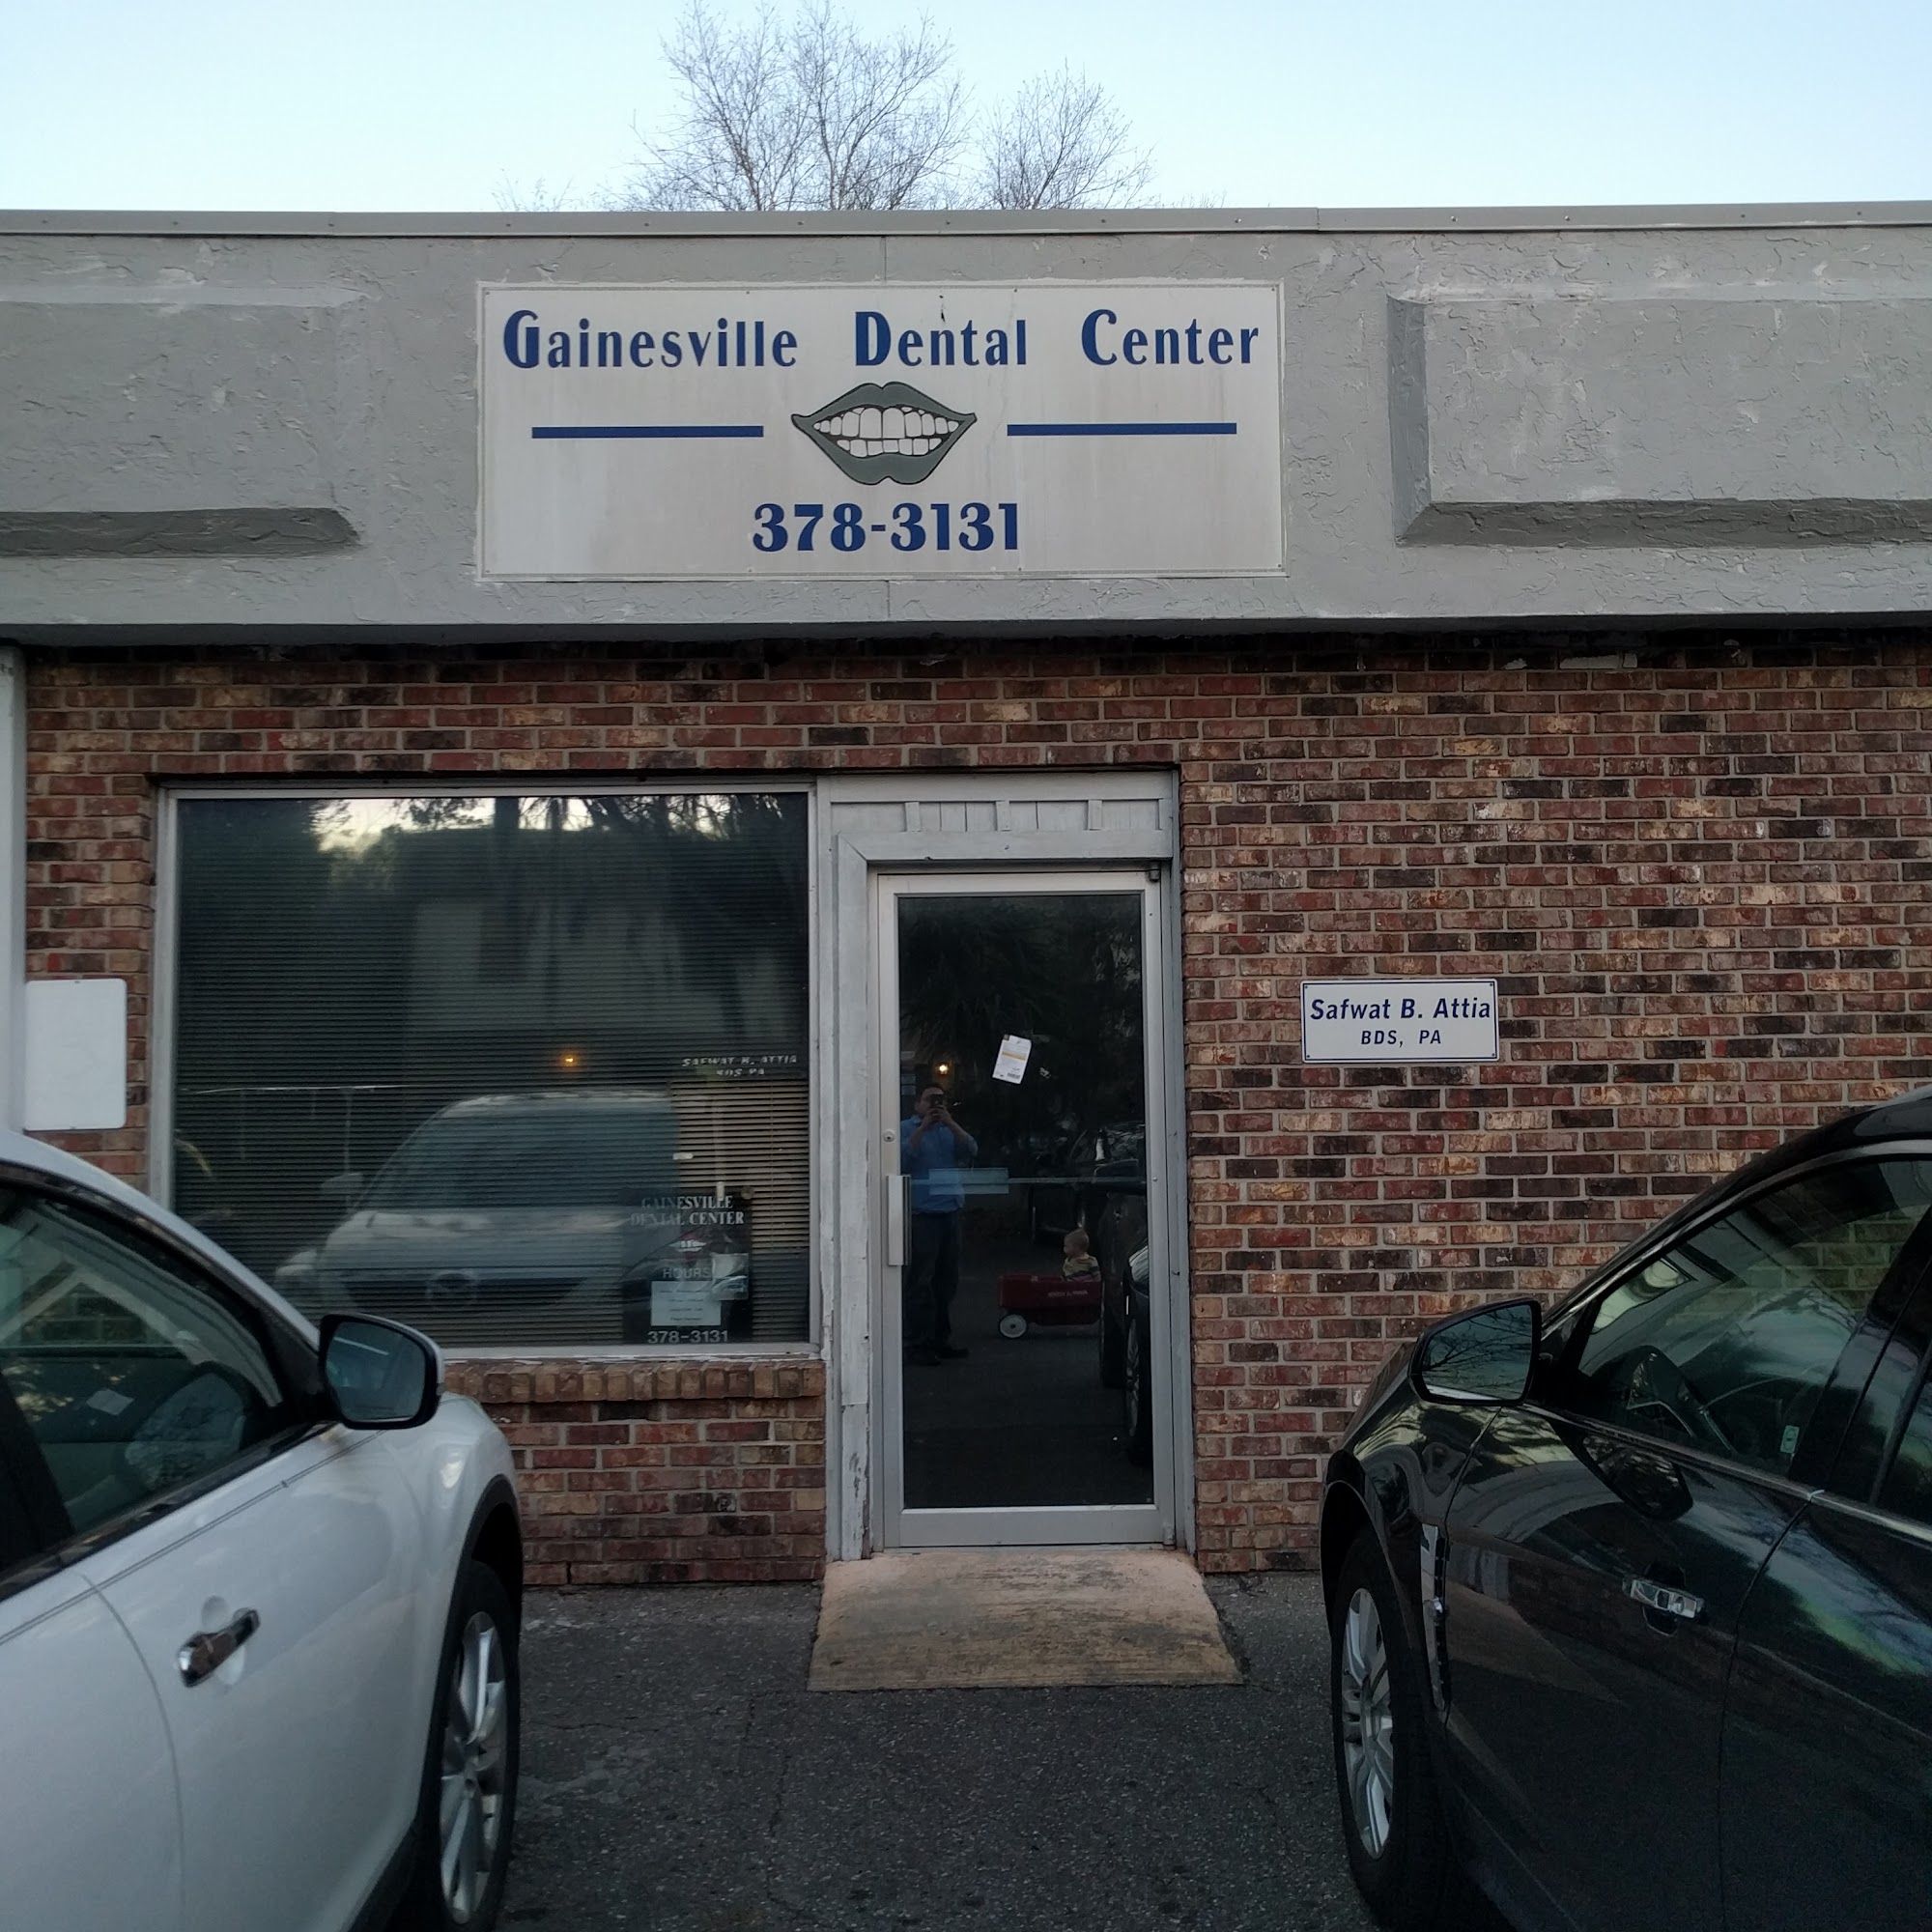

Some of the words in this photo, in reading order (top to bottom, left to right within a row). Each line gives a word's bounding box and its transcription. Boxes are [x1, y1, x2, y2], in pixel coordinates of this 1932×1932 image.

[503, 309, 798, 369] Gainesville
[855, 311, 1027, 367] Dental
[1081, 308, 1260, 366] Center
[753, 502, 1018, 552] 378-3131
[1310, 999, 1391, 1020] Safwat
[1401, 998, 1424, 1019] B.
[1433, 997, 1492, 1019] Attia
[1360, 1030, 1404, 1048] BDS,
[1418, 1030, 1442, 1044] PA
[689, 1210, 745, 1225] CENTER
[647, 1329, 728, 1344] 378-3131
